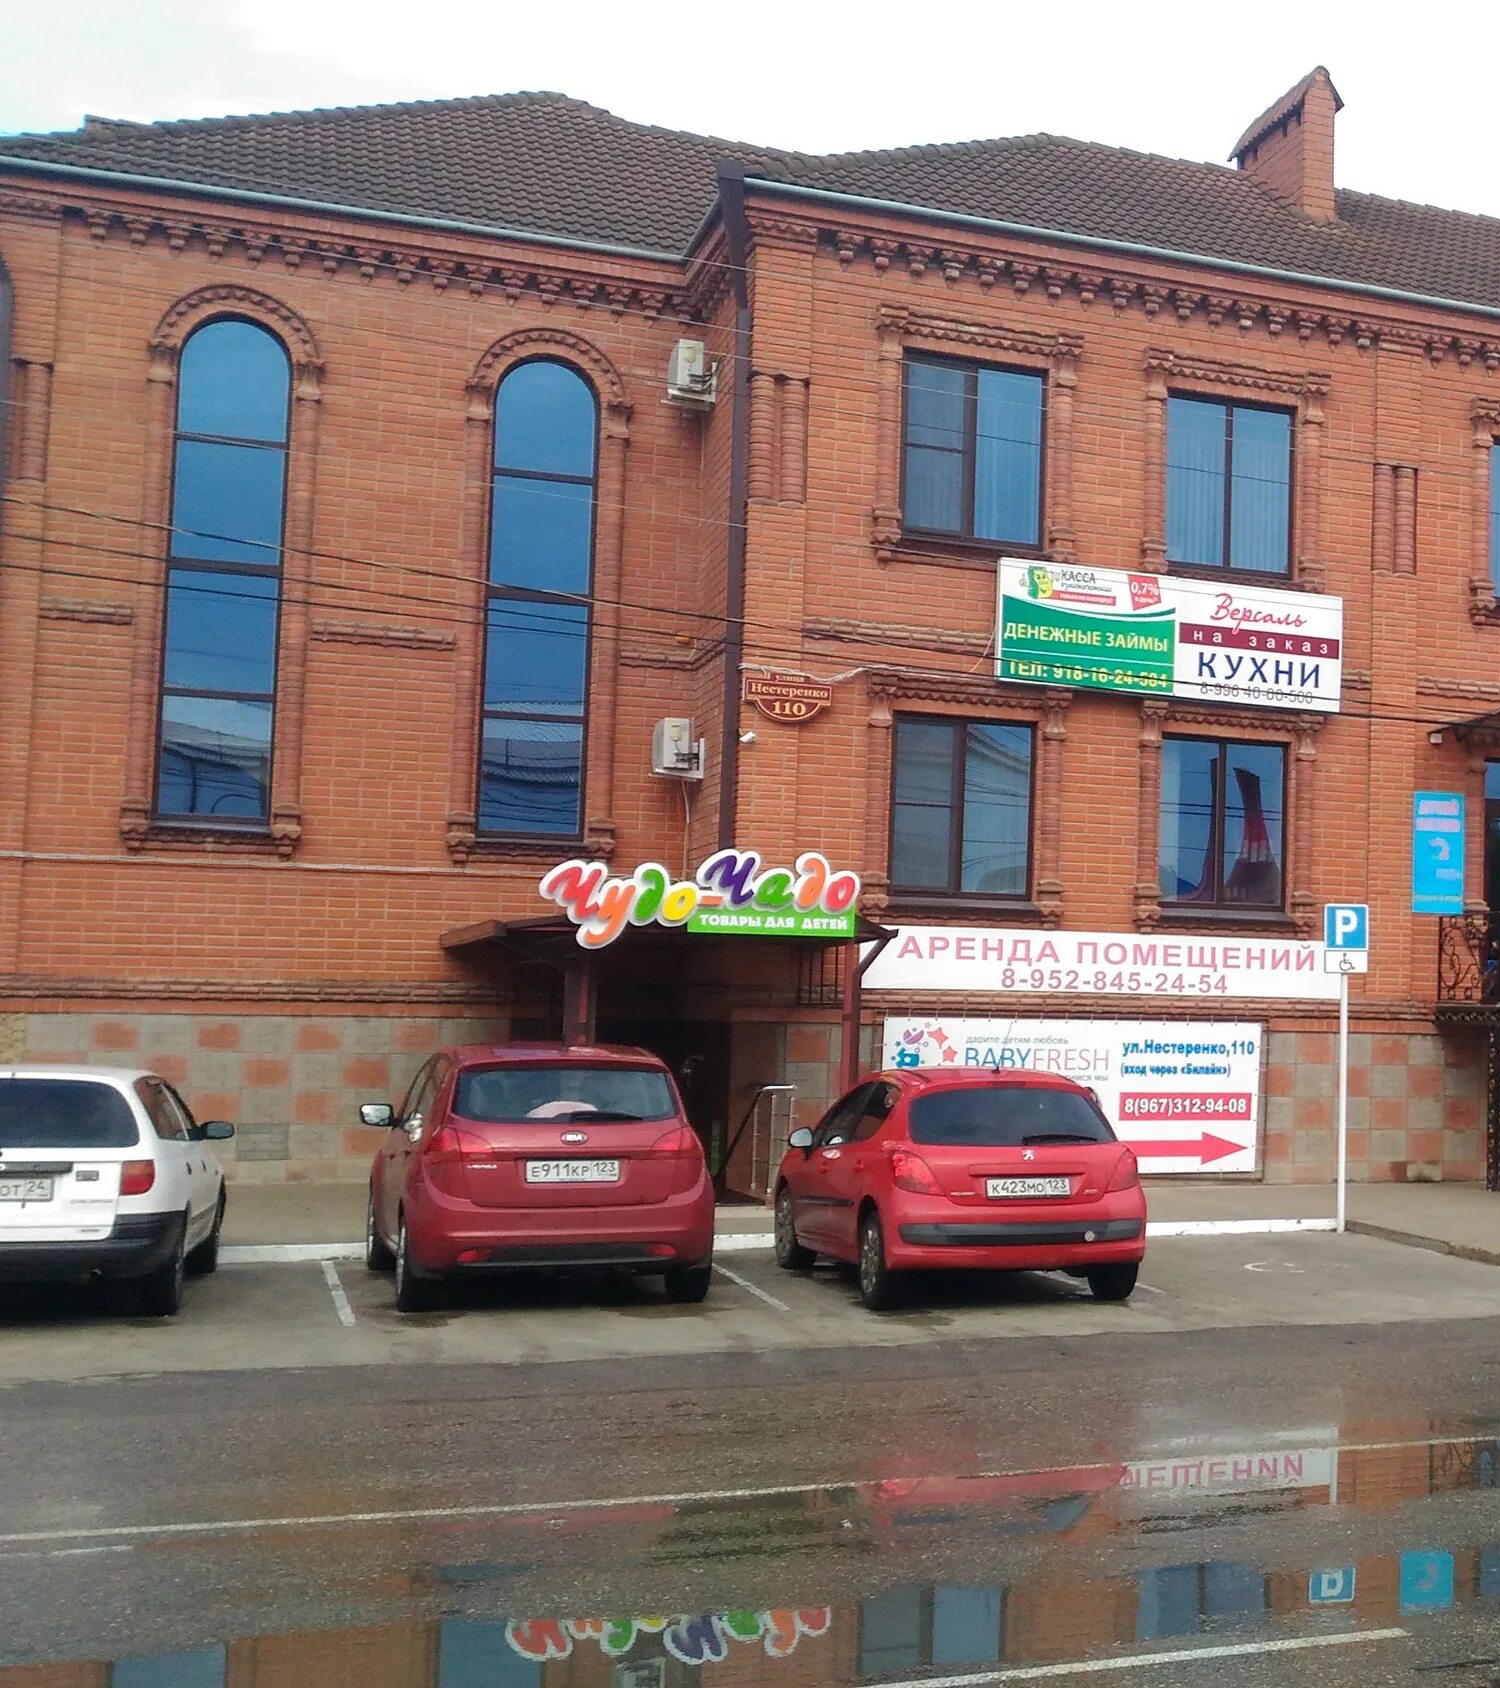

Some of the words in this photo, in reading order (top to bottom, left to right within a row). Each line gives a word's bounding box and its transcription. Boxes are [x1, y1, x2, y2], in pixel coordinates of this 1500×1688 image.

[1061, 570, 1096, 584] КАССА
[1131, 582, 1159, 596] 0,7%
[1209, 592, 1308, 635] Версаль
[1004, 622, 1102, 646] ДЕНЕЖНЫЕ
[1105, 632, 1168, 652] ЗАЙМЫ
[1193, 630, 1222, 643] на
[1248, 636, 1328, 654] заказ
[1198, 651, 1320, 689] КУХНИ
[751, 683, 828, 698] Нестеренко
[772, 701, 806, 716] 110
[543, 851, 858, 947] Чудо-Чадо
[699, 914, 760, 927] ТОВАРЫ
[764, 916, 795, 928] ДЛЯ
[801, 916, 848, 930] ДЕТЕЙ
[1335, 909, 1358, 945] P
[897, 935, 1060, 966] АРЕНДА
[1077, 941, 1316, 972] ПОМЕЩЕНИЙ
[1001, 968, 1228, 994] 8-952-845-24-54
[965, 1036, 1000, 1044] дарите
[1001, 1036, 1031, 1044] детям
[1033, 1036, 1069, 1044] любовь
[964, 1047, 1110, 1071] BABYFRESH
[1120, 1062, 1147, 1077] (вход
[1149, 1065, 1178, 1077] через
[1124, 1098, 1247, 1117] 8(967)312-94-08
[531, 1163, 590, 1177] Е911КР
[593, 1161, 616, 1173] 123
[26, 1181, 45, 1192] 24
[991, 1180, 1045, 1195] К423МО
[1046, 1179, 1067, 1190] 123
